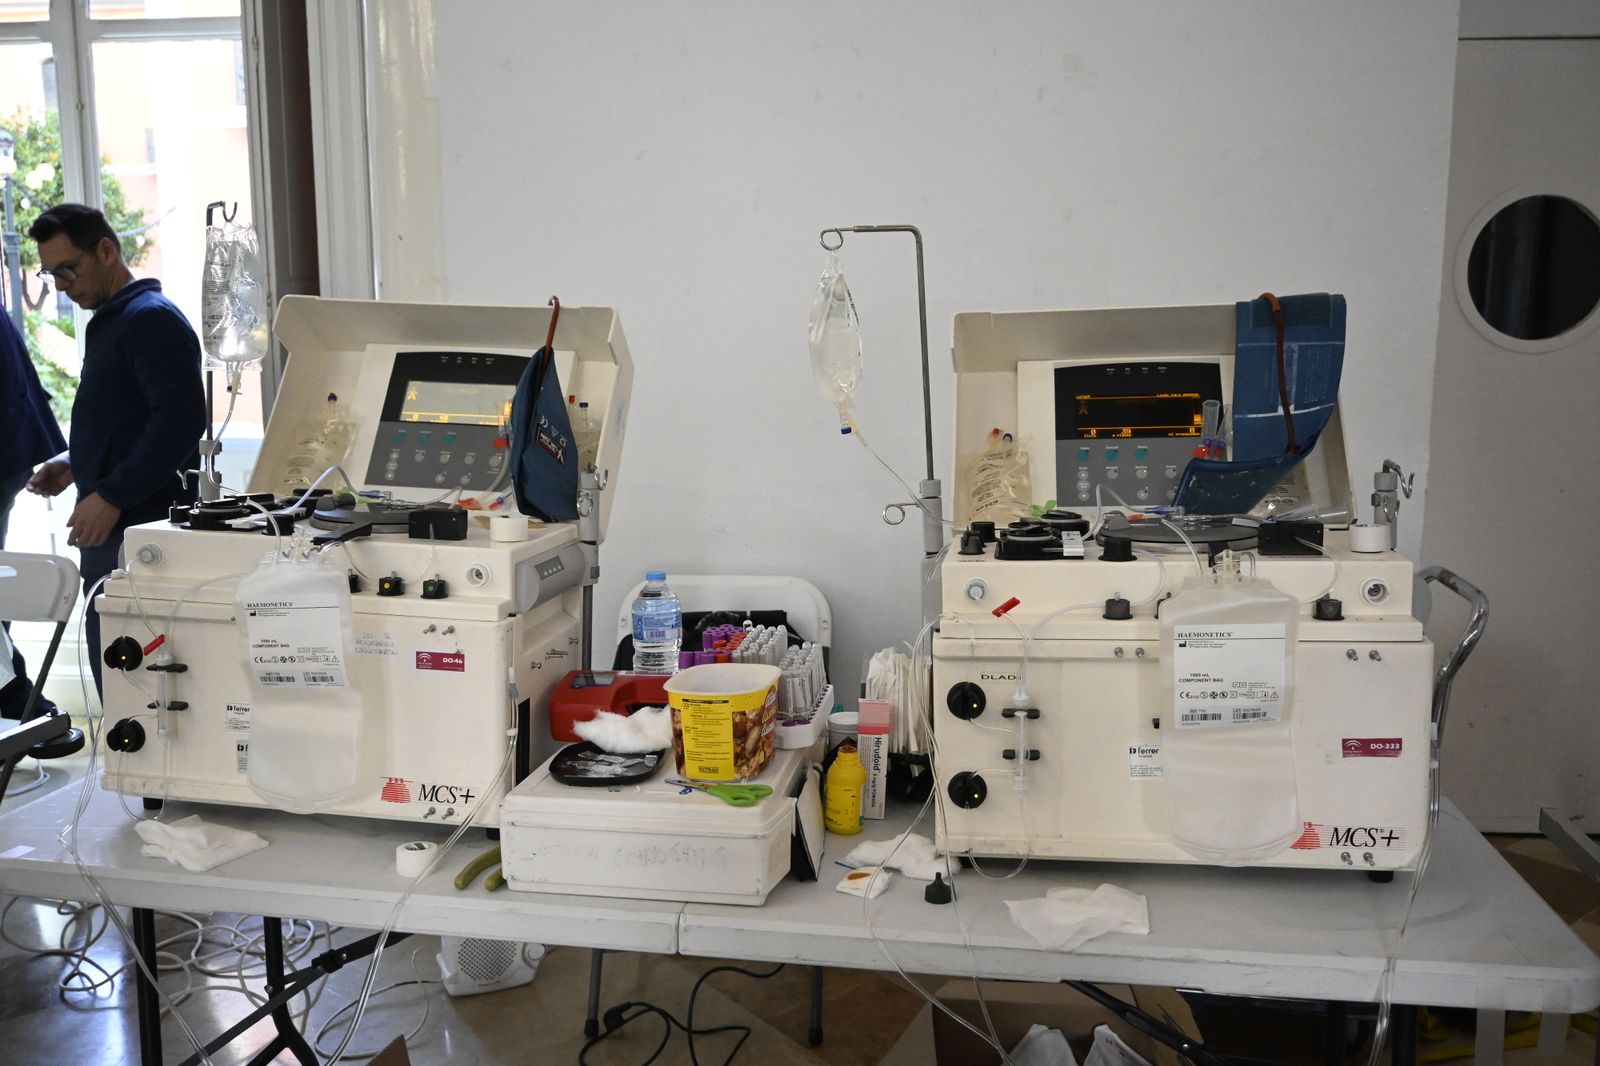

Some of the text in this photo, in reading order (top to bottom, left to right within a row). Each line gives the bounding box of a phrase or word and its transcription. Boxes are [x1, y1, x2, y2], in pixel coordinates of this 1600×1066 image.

[233, 705, 250, 713] ferrer
[873, 737, 882, 772] Hirudoid
[1137, 746, 1159, 755] ferrer
